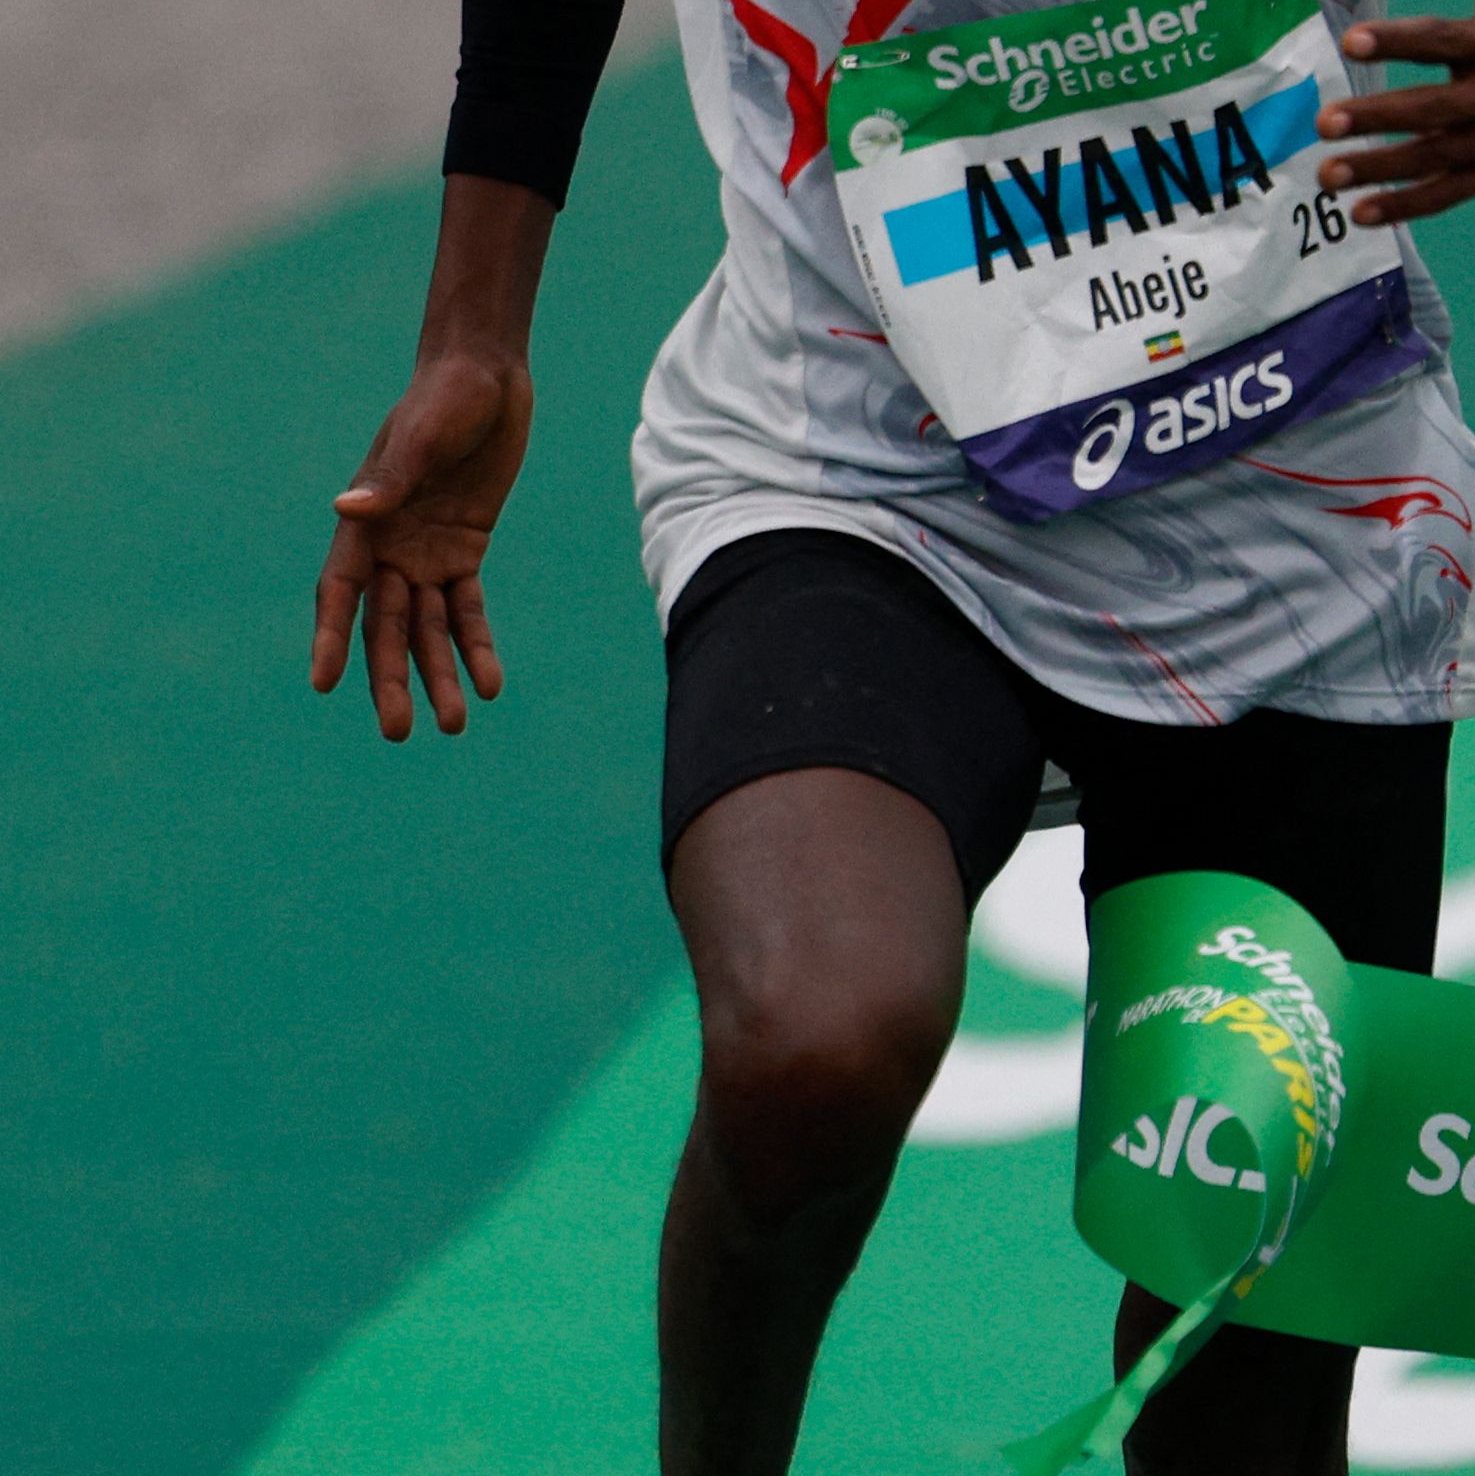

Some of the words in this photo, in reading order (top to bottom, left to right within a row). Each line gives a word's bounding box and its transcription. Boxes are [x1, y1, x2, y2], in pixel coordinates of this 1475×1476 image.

[1059, 38, 1216, 97] Electric
[964, 100, 1275, 284] AYANA
[1292, 189, 1348, 260] 26
[1088, 256, 1210, 330] Abeje
[1143, 350, 1294, 456] asics
[1116, 984, 1236, 1036] MARATHON
[1201, 996, 1317, 1180] PARIS
